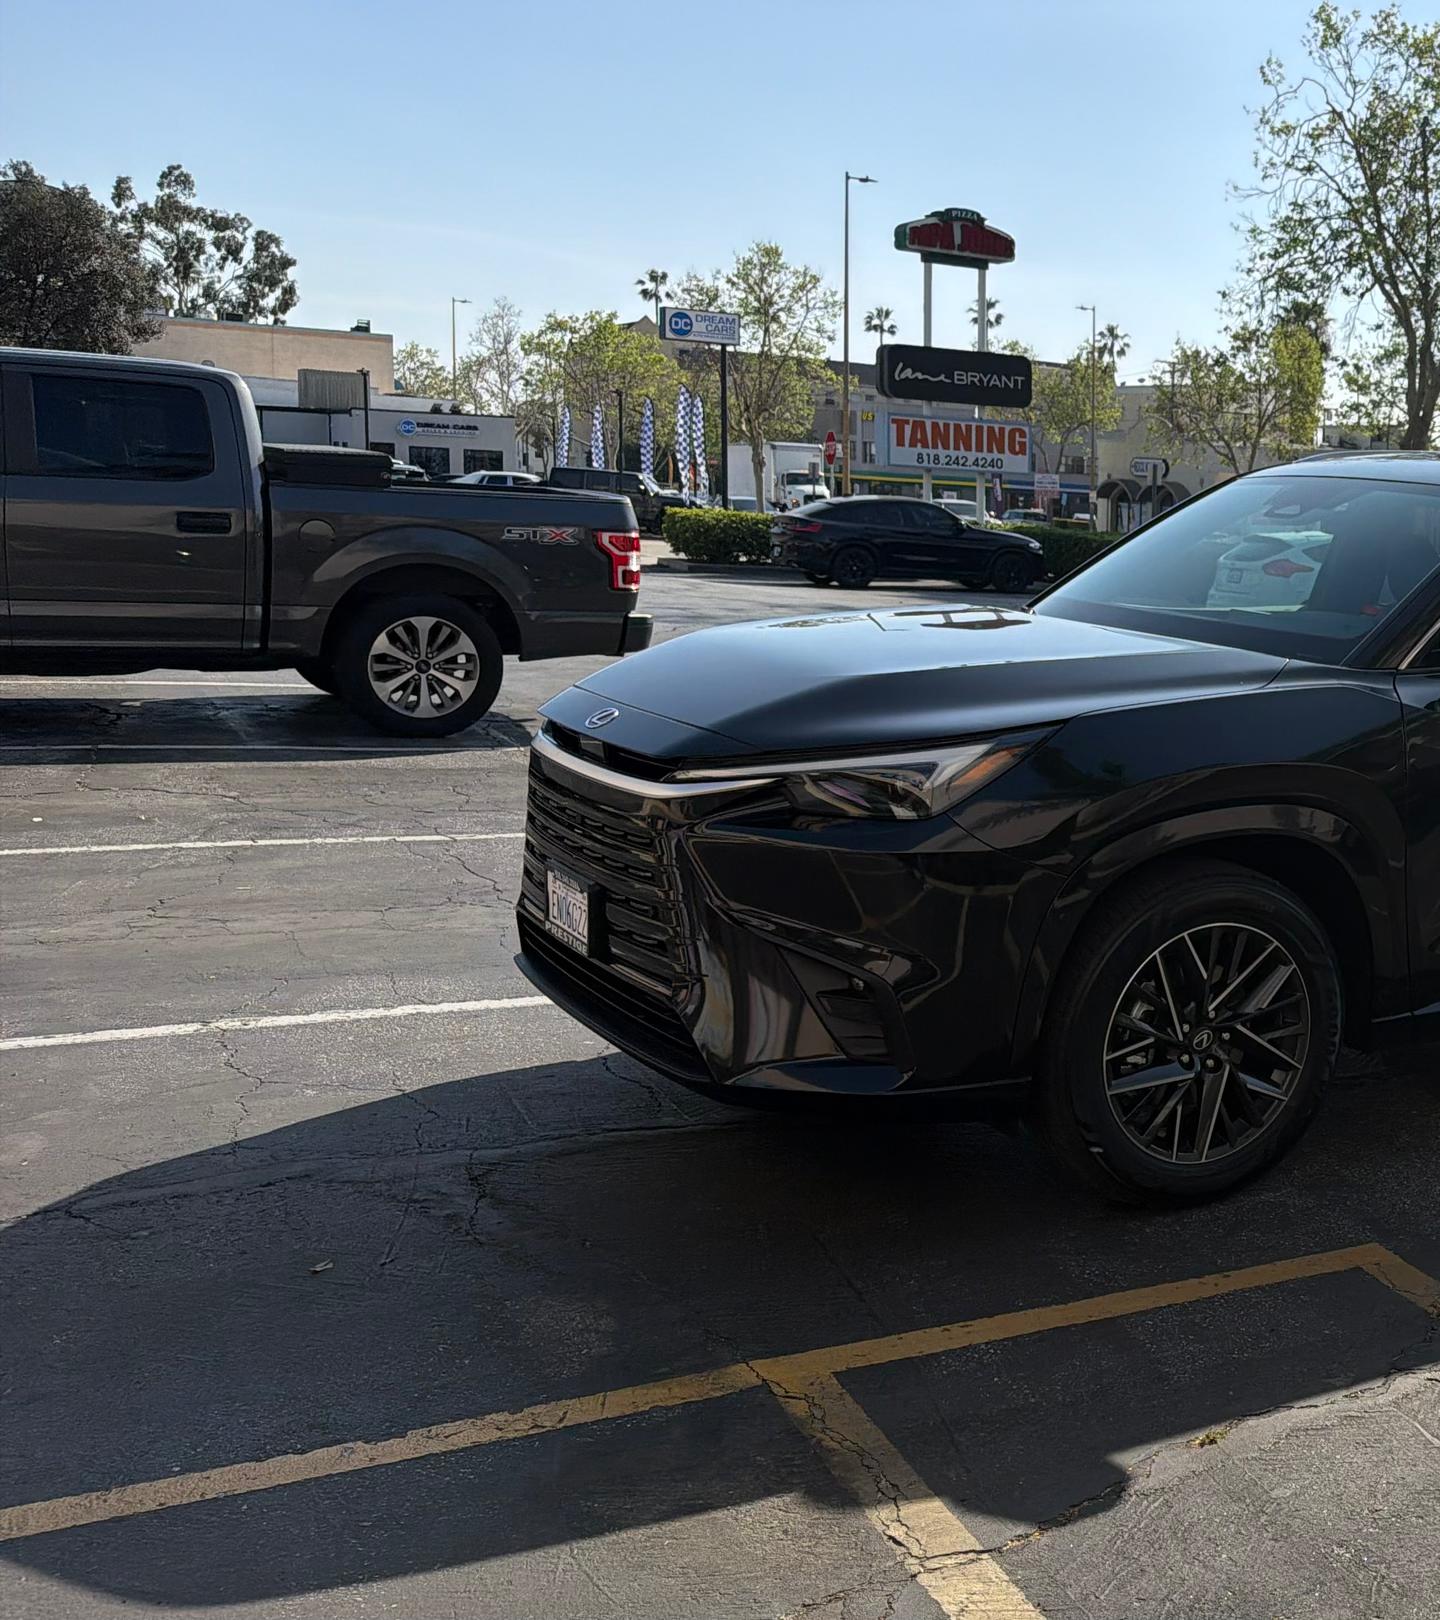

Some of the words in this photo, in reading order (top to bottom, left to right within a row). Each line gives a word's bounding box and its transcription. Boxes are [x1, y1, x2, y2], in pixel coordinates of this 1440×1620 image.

[951, 210, 978, 220] PIZZA
[671, 317, 692, 330] DC
[695, 314, 736, 326] DREAM
[705, 324, 736, 334] CARS
[954, 371, 1026, 390] BRYANT
[891, 418, 1027, 456] TANNING
[916, 452, 1004, 469] 818.242.4240
[501, 526, 579, 546] STX
[544, 919, 589, 957] PRESTIGE
